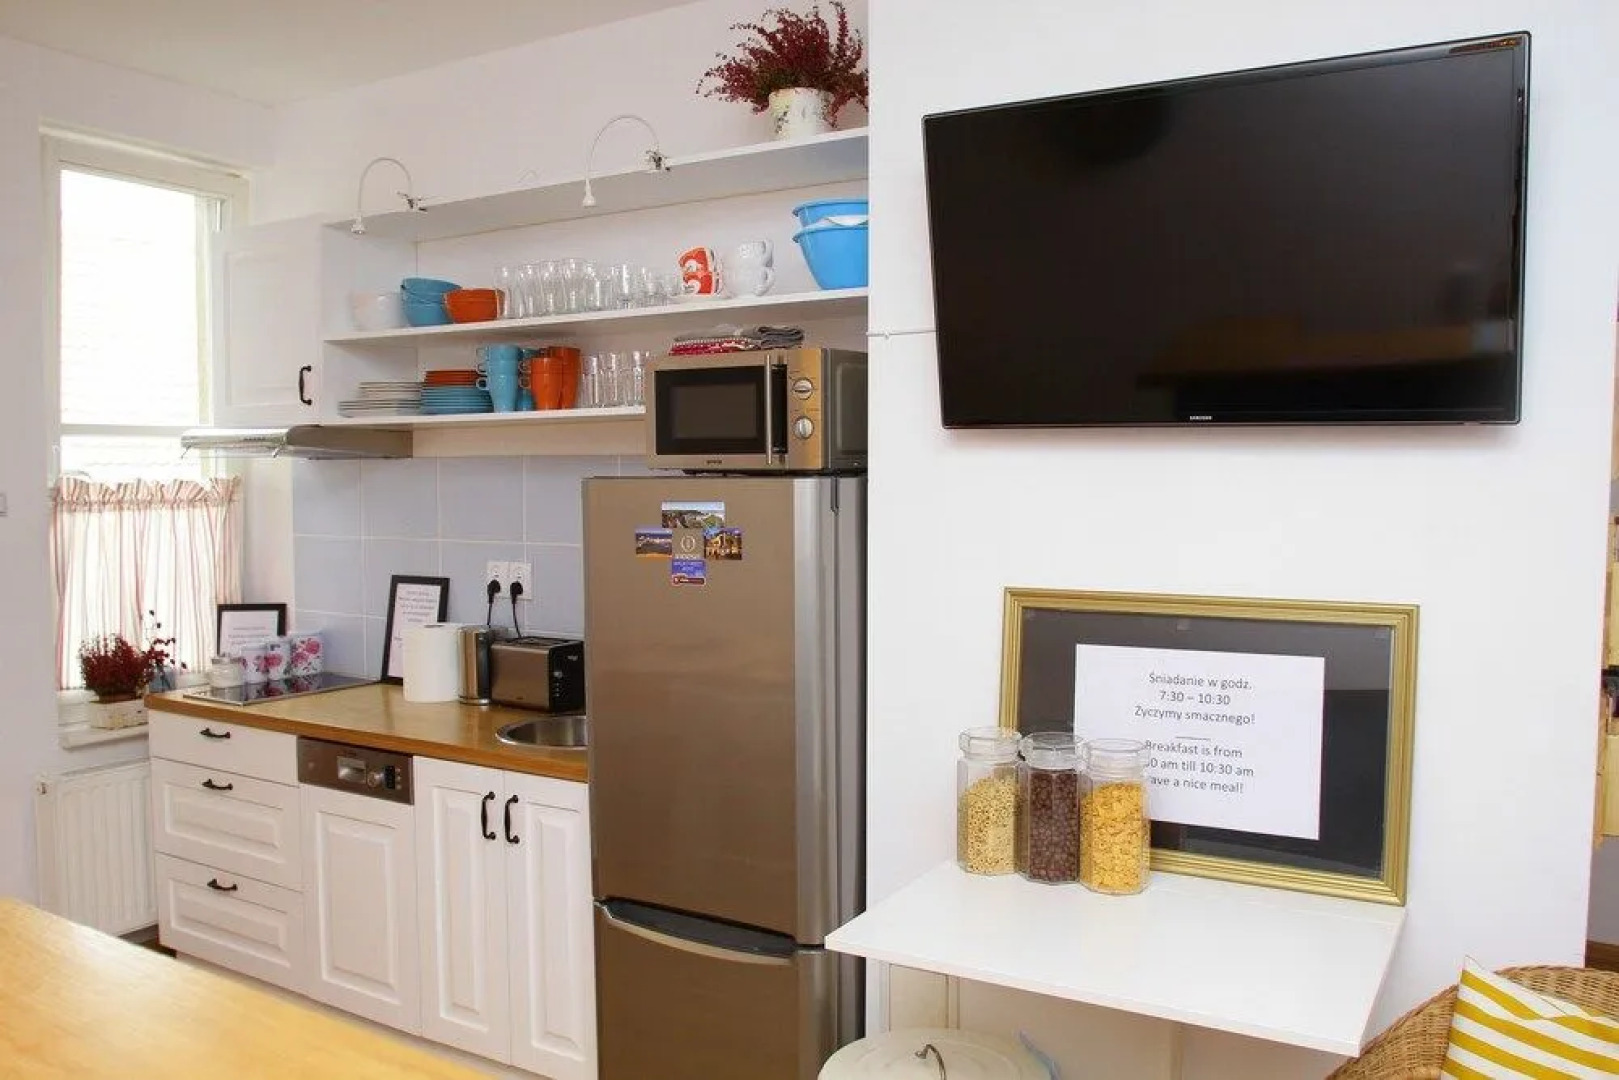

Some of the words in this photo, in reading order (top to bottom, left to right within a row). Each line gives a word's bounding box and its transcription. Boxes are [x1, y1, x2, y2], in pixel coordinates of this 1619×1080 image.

[1207, 679, 1219, 688] w
[1220, 677, 1252, 690] godz.
[1160, 690, 1185, 702] 7:30
[1198, 692, 1231, 705] 10:30
[1184, 711, 1256, 726] smacznego!
[1201, 746, 1211, 756] is
[1213, 745, 1243, 758] from
[1160, 761, 1178, 770] am
[1181, 760, 1196, 772] till
[1200, 762, 1233, 775] 10:30
[1235, 766, 1254, 777] am
[1148, 776, 1170, 786] ave
[1173, 779, 1180, 788] a
[1183, 779, 1207, 790] nice
[1210, 781, 1244, 794] meal!
